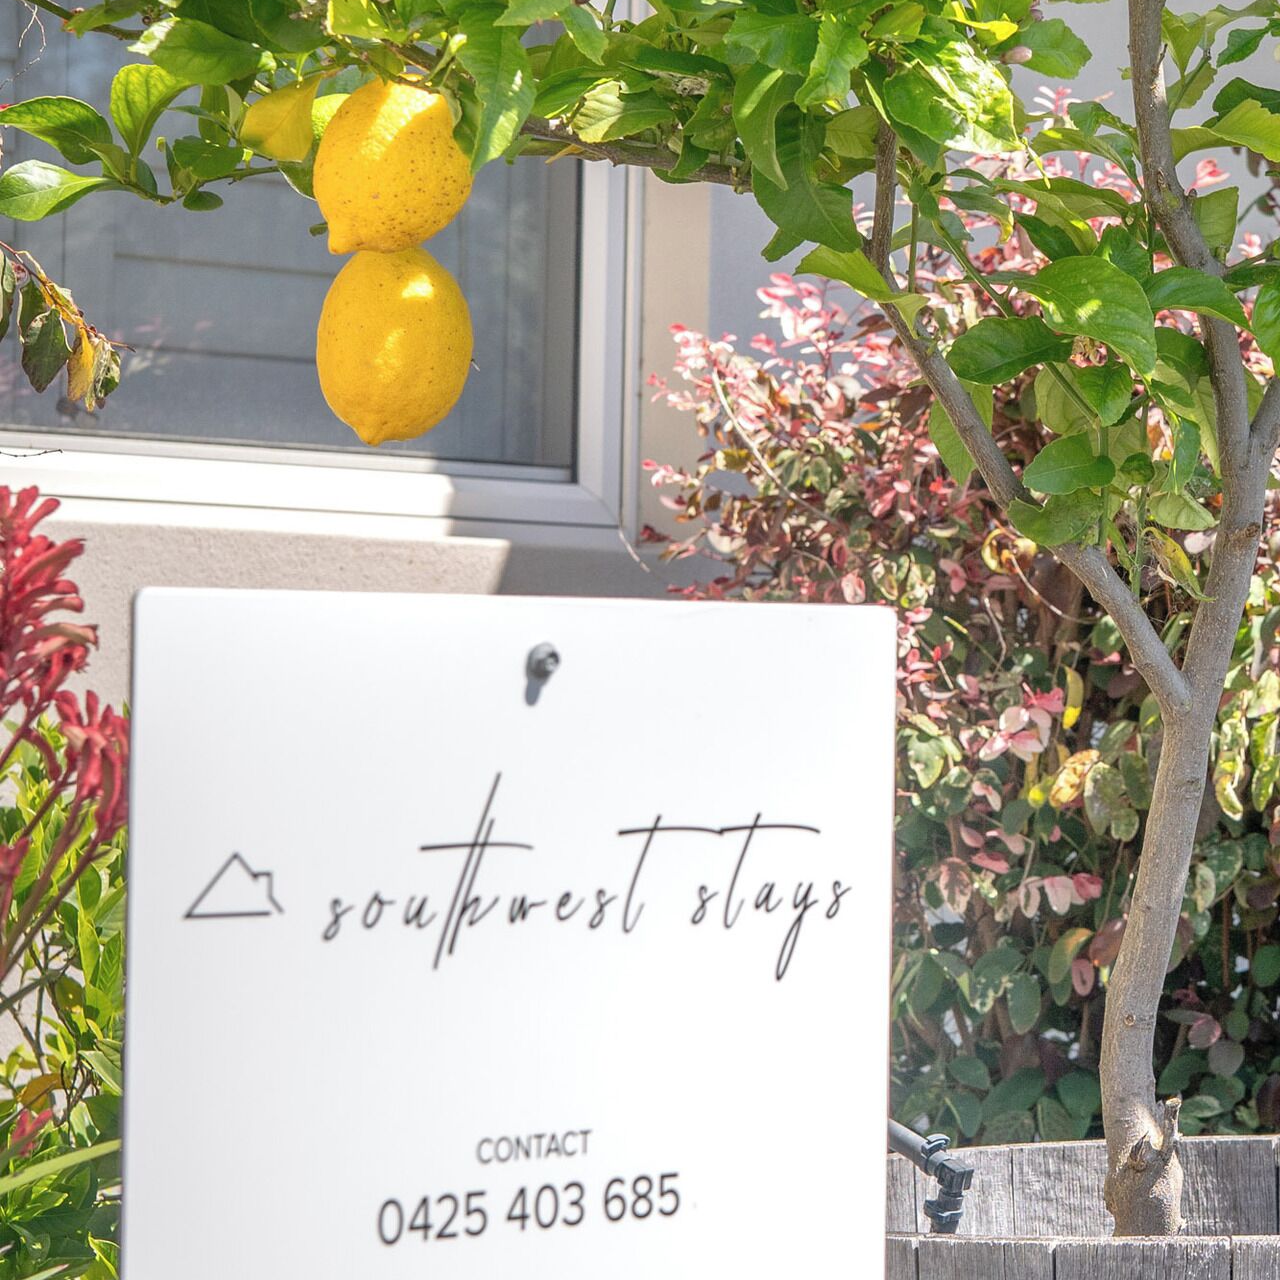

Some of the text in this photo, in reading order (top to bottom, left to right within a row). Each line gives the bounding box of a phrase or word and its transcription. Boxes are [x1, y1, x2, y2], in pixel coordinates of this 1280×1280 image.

[322, 772, 852, 983] southwest stays
[475, 1129, 591, 1165] CONTACT
[377, 1172, 681, 1246] 0425 403 685
